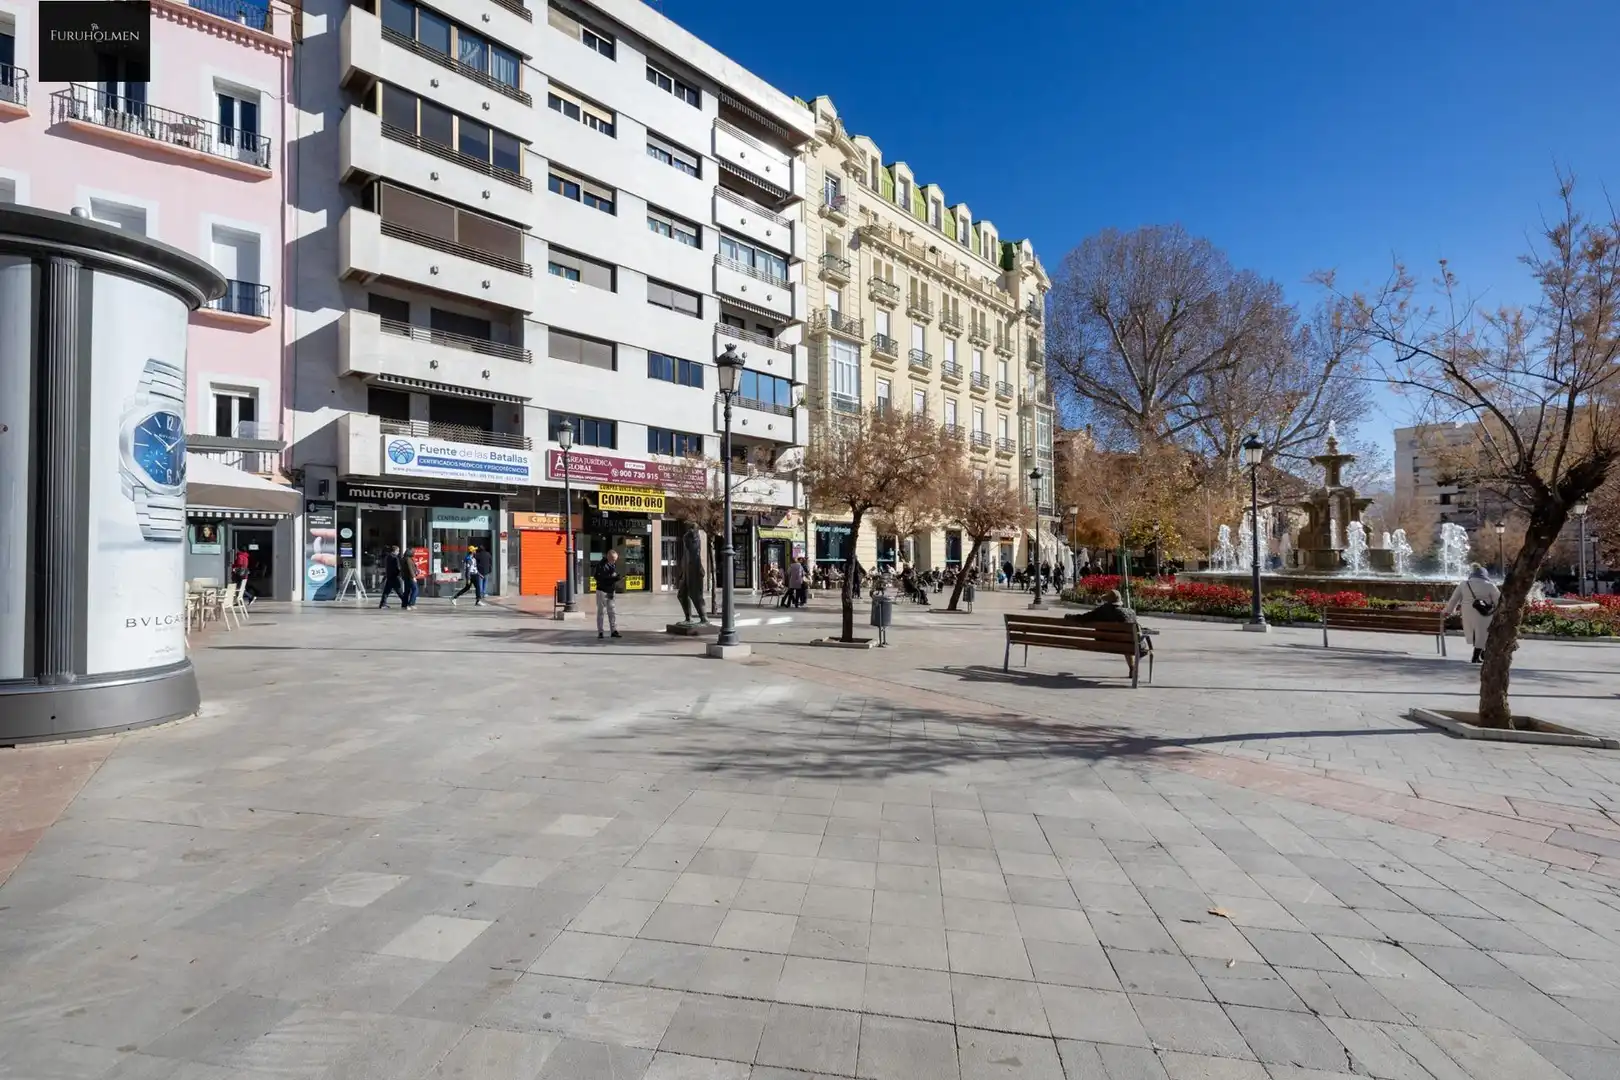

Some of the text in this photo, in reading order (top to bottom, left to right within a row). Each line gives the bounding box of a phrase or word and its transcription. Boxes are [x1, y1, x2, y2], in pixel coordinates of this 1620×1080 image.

[420, 444, 528, 464] Fuente de las Batallas
[419, 458, 459, 467] CERTIFICADOS
[459, 461, 484, 469] MÉDICOS
[487, 464, 528, 474] PSICOTÉCNICOS
[568, 463, 593, 472] GLOBAL
[601, 493, 663, 509] COMPRO ORO
[437, 514, 460, 522] CENTRO
